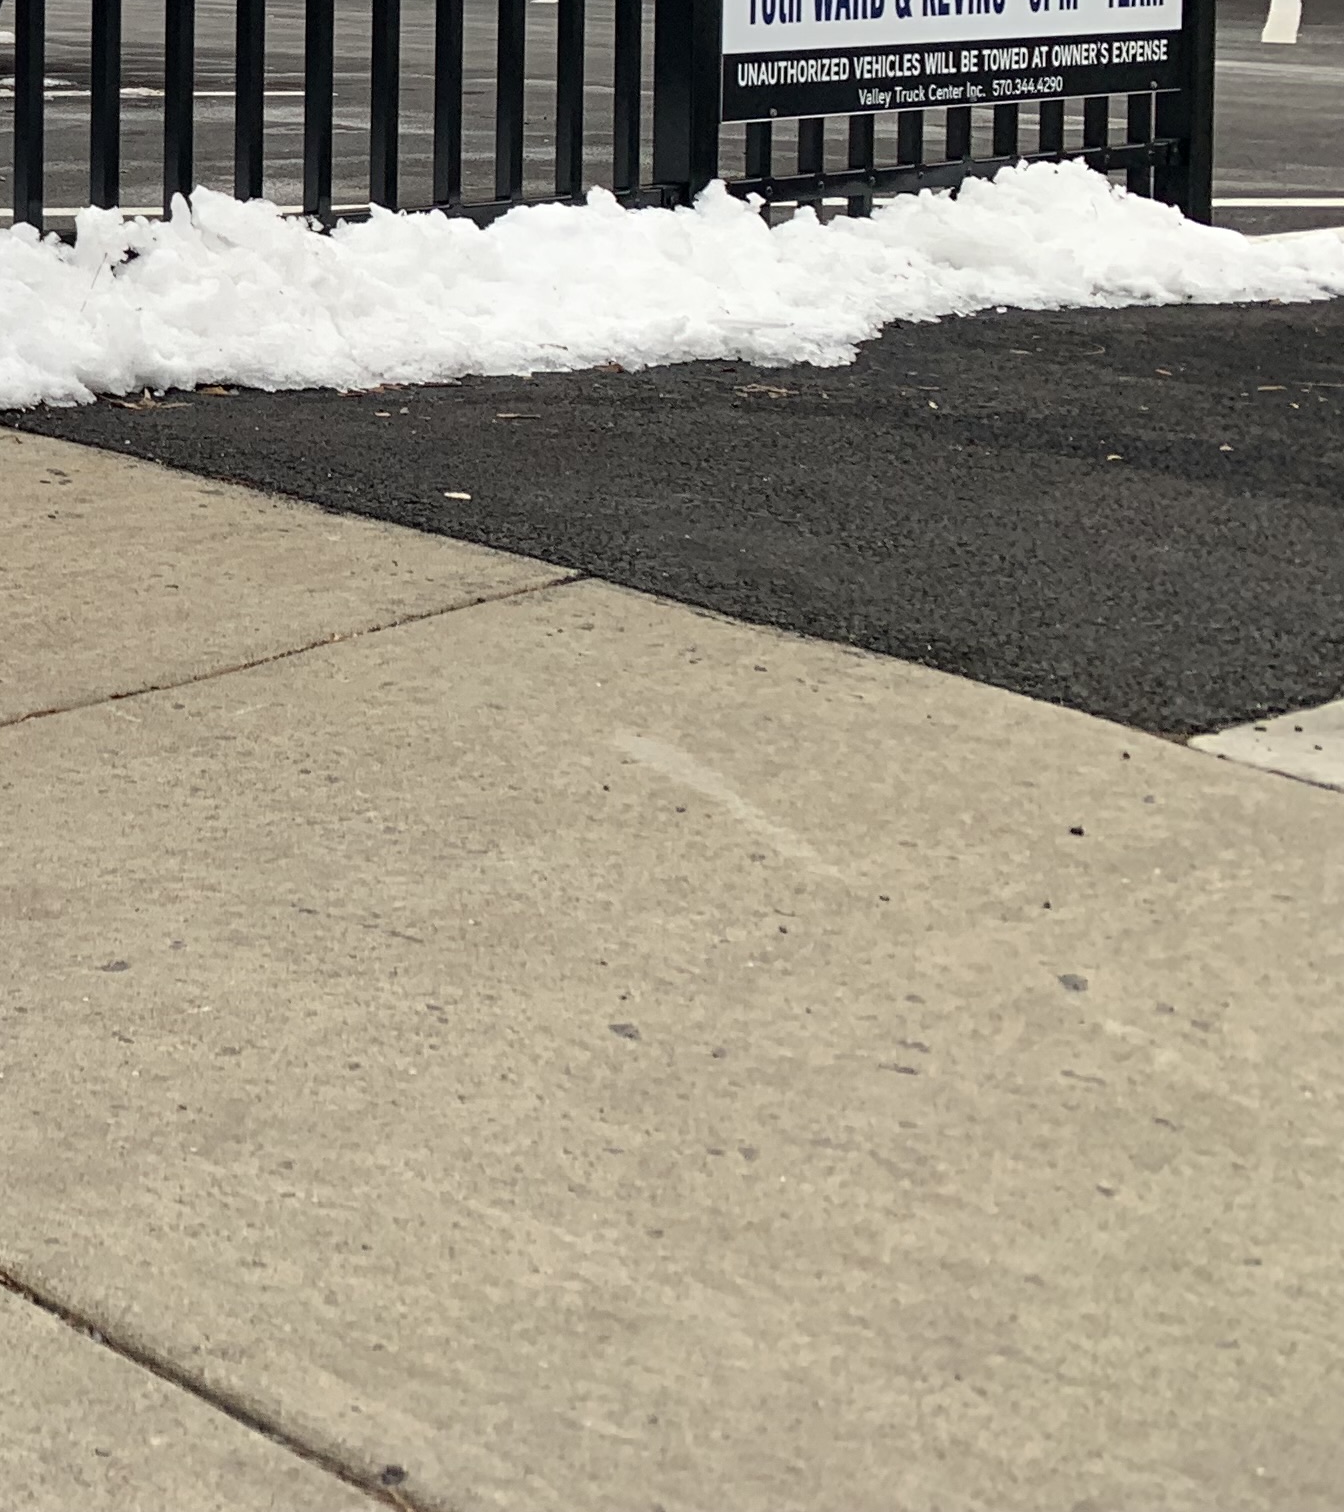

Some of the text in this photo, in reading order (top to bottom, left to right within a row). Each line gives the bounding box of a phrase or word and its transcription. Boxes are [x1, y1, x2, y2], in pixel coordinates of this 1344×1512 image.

[737, 39, 1168, 86] UNAUTHORIZED VEHICLES WILL BE TOWED AT OWNER'S EXPENSE
[858, 76, 1063, 108] Valley Truck Center Inc. 570.344.4290
